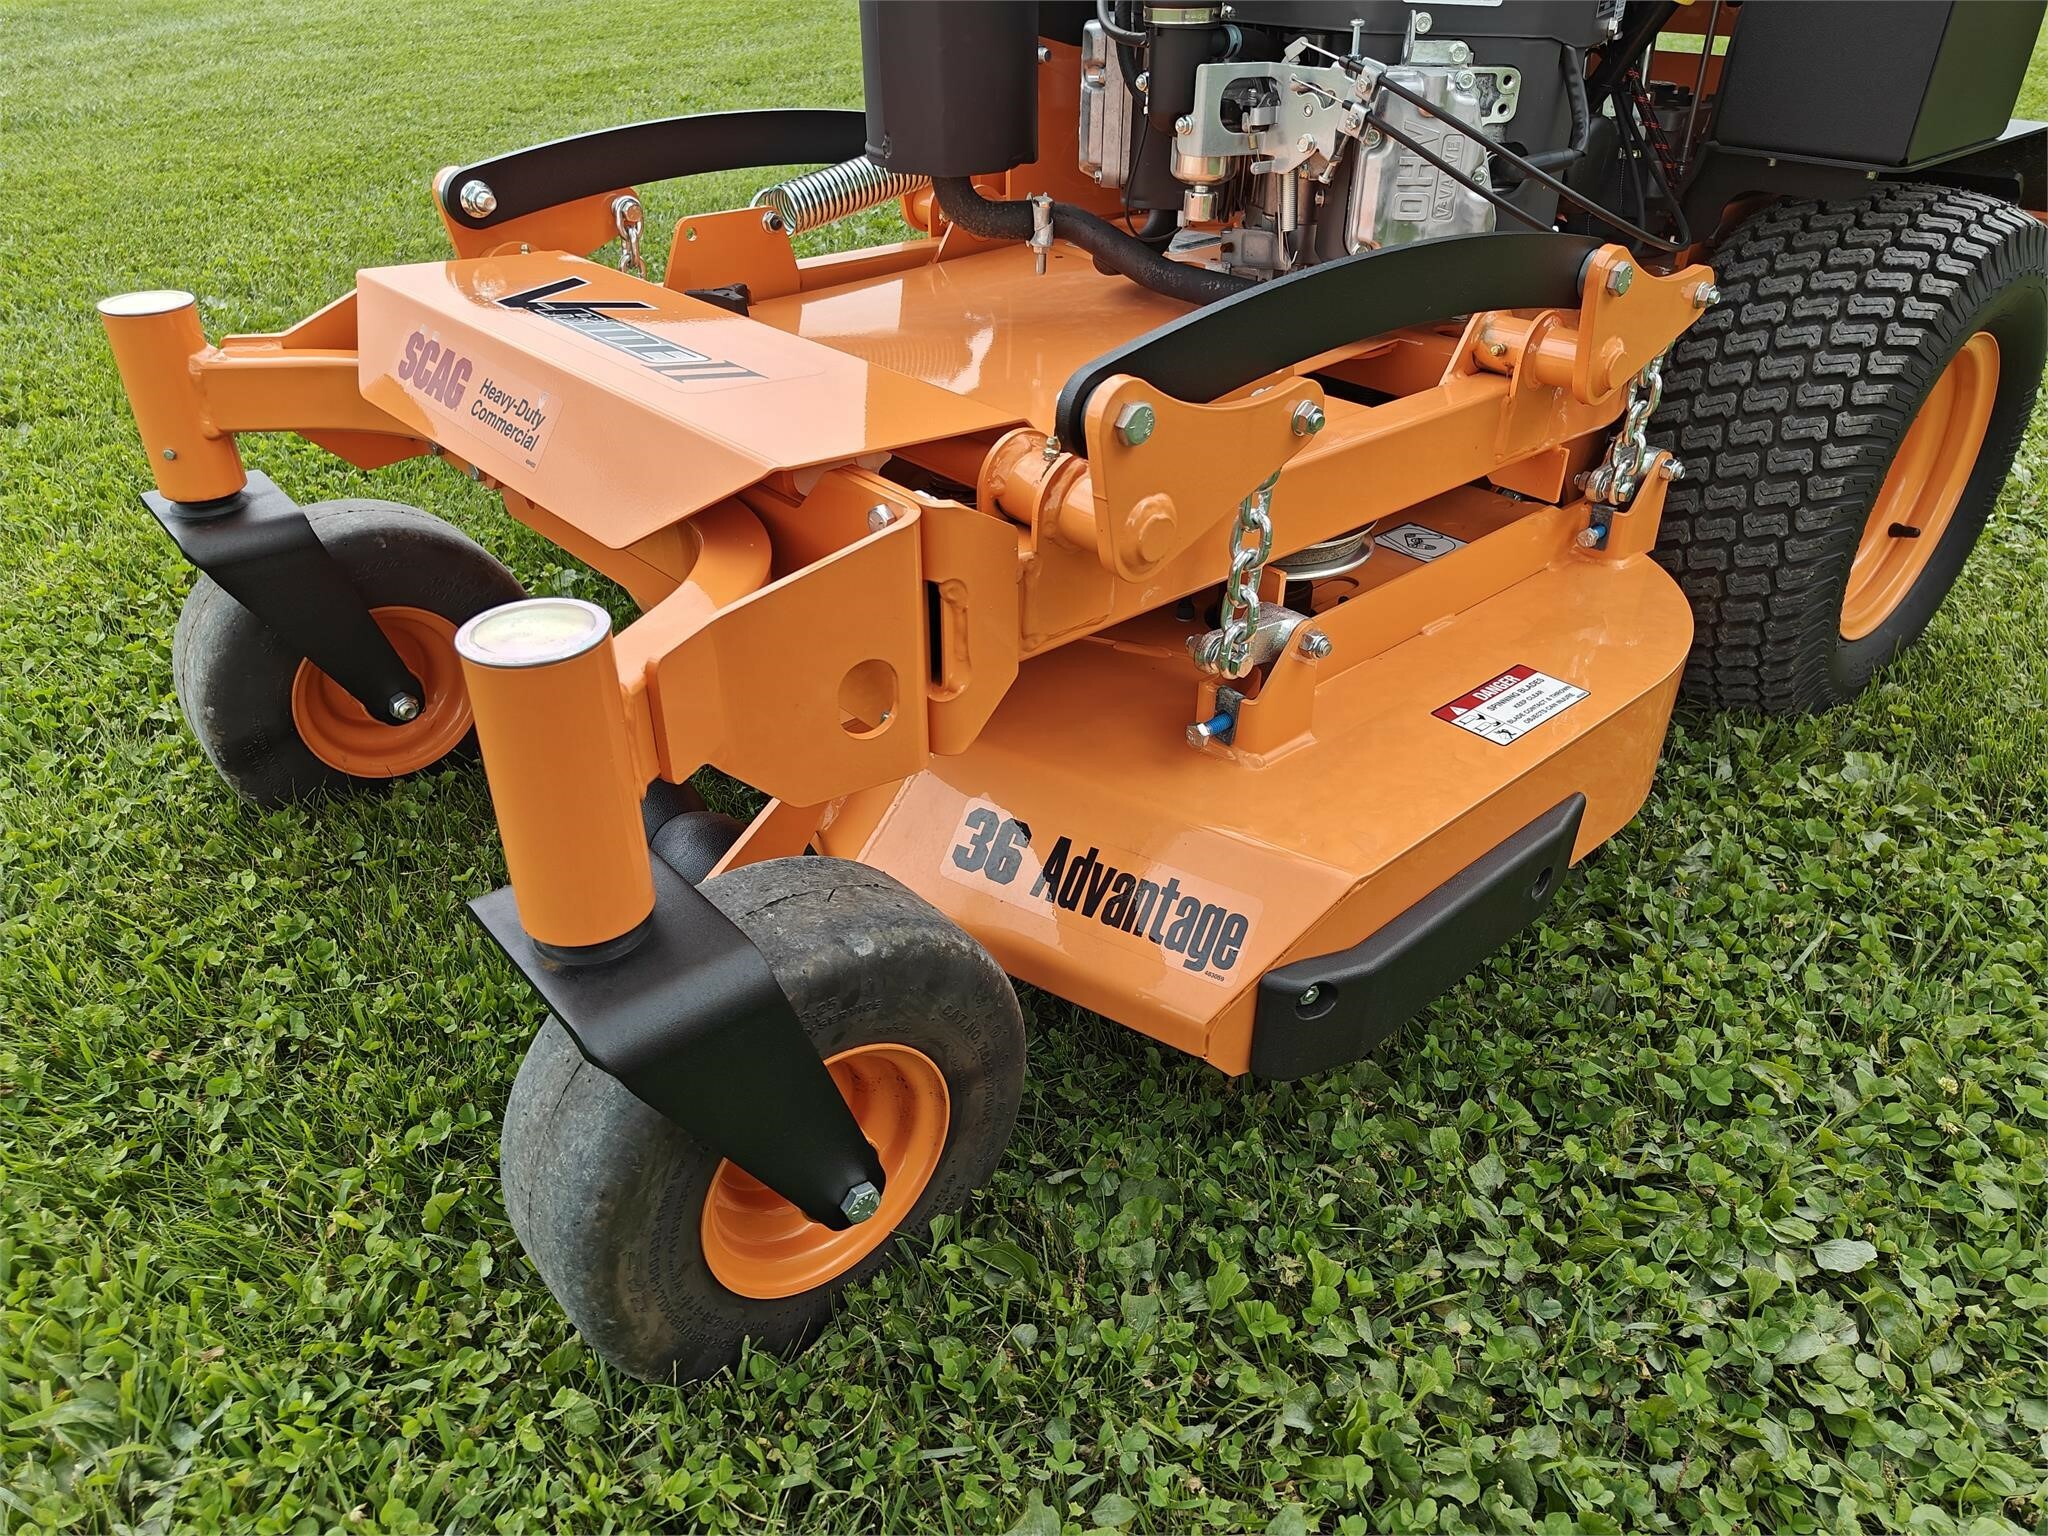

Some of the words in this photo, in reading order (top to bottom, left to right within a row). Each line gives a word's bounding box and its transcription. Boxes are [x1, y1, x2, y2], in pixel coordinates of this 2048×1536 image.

[398, 331, 473, 410] SCAG
[479, 378, 546, 431] Heavy-Duty
[471, 400, 540, 451] Commercial
[1472, 675, 1521, 701] DANGER
[1487, 691, 1520, 711] SPINNING
[1517, 678, 1545, 694] BLADES
[1507, 713, 1525, 724] BLADE
[1524, 700, 1547, 715] CONTACT
[1550, 686, 1572, 698] THROWN
[1513, 699, 1527, 709] KEEP
[1526, 690, 1544, 701] CLEAR
[1523, 708, 1548, 723] OBJECTS
[1545, 702, 1559, 711] CAN
[1556, 692, 1575, 704] INJURE
[951, 807, 1032, 885] 36
[1030, 835, 1249, 972] Advantage
